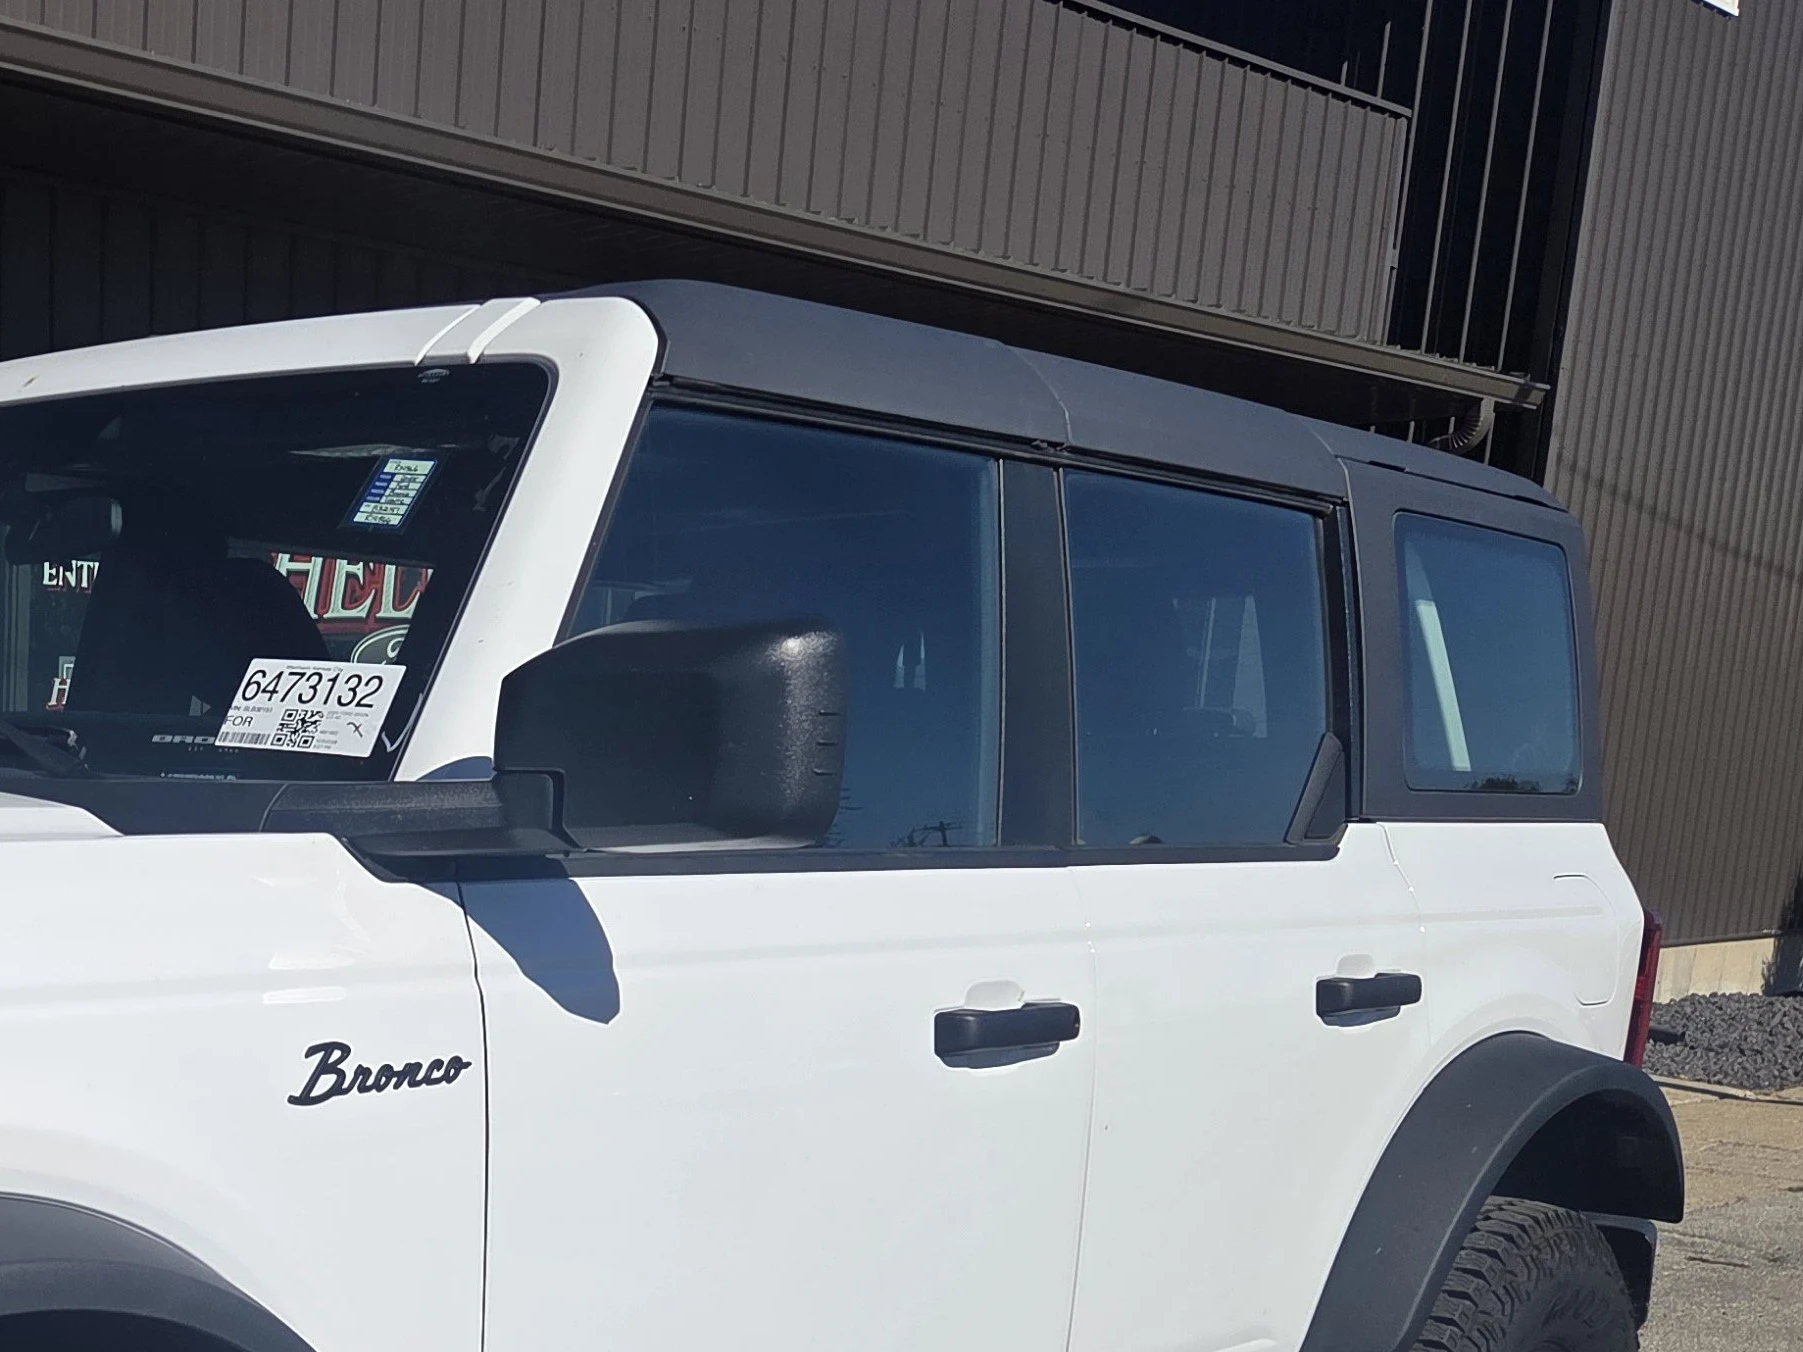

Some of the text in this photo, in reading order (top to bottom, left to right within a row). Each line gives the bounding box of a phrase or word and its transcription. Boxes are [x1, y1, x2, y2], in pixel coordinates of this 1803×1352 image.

[43, 559, 100, 588] ENT
[241, 669, 384, 709] 6473132
[287, 1041, 472, 1106] Bronco
